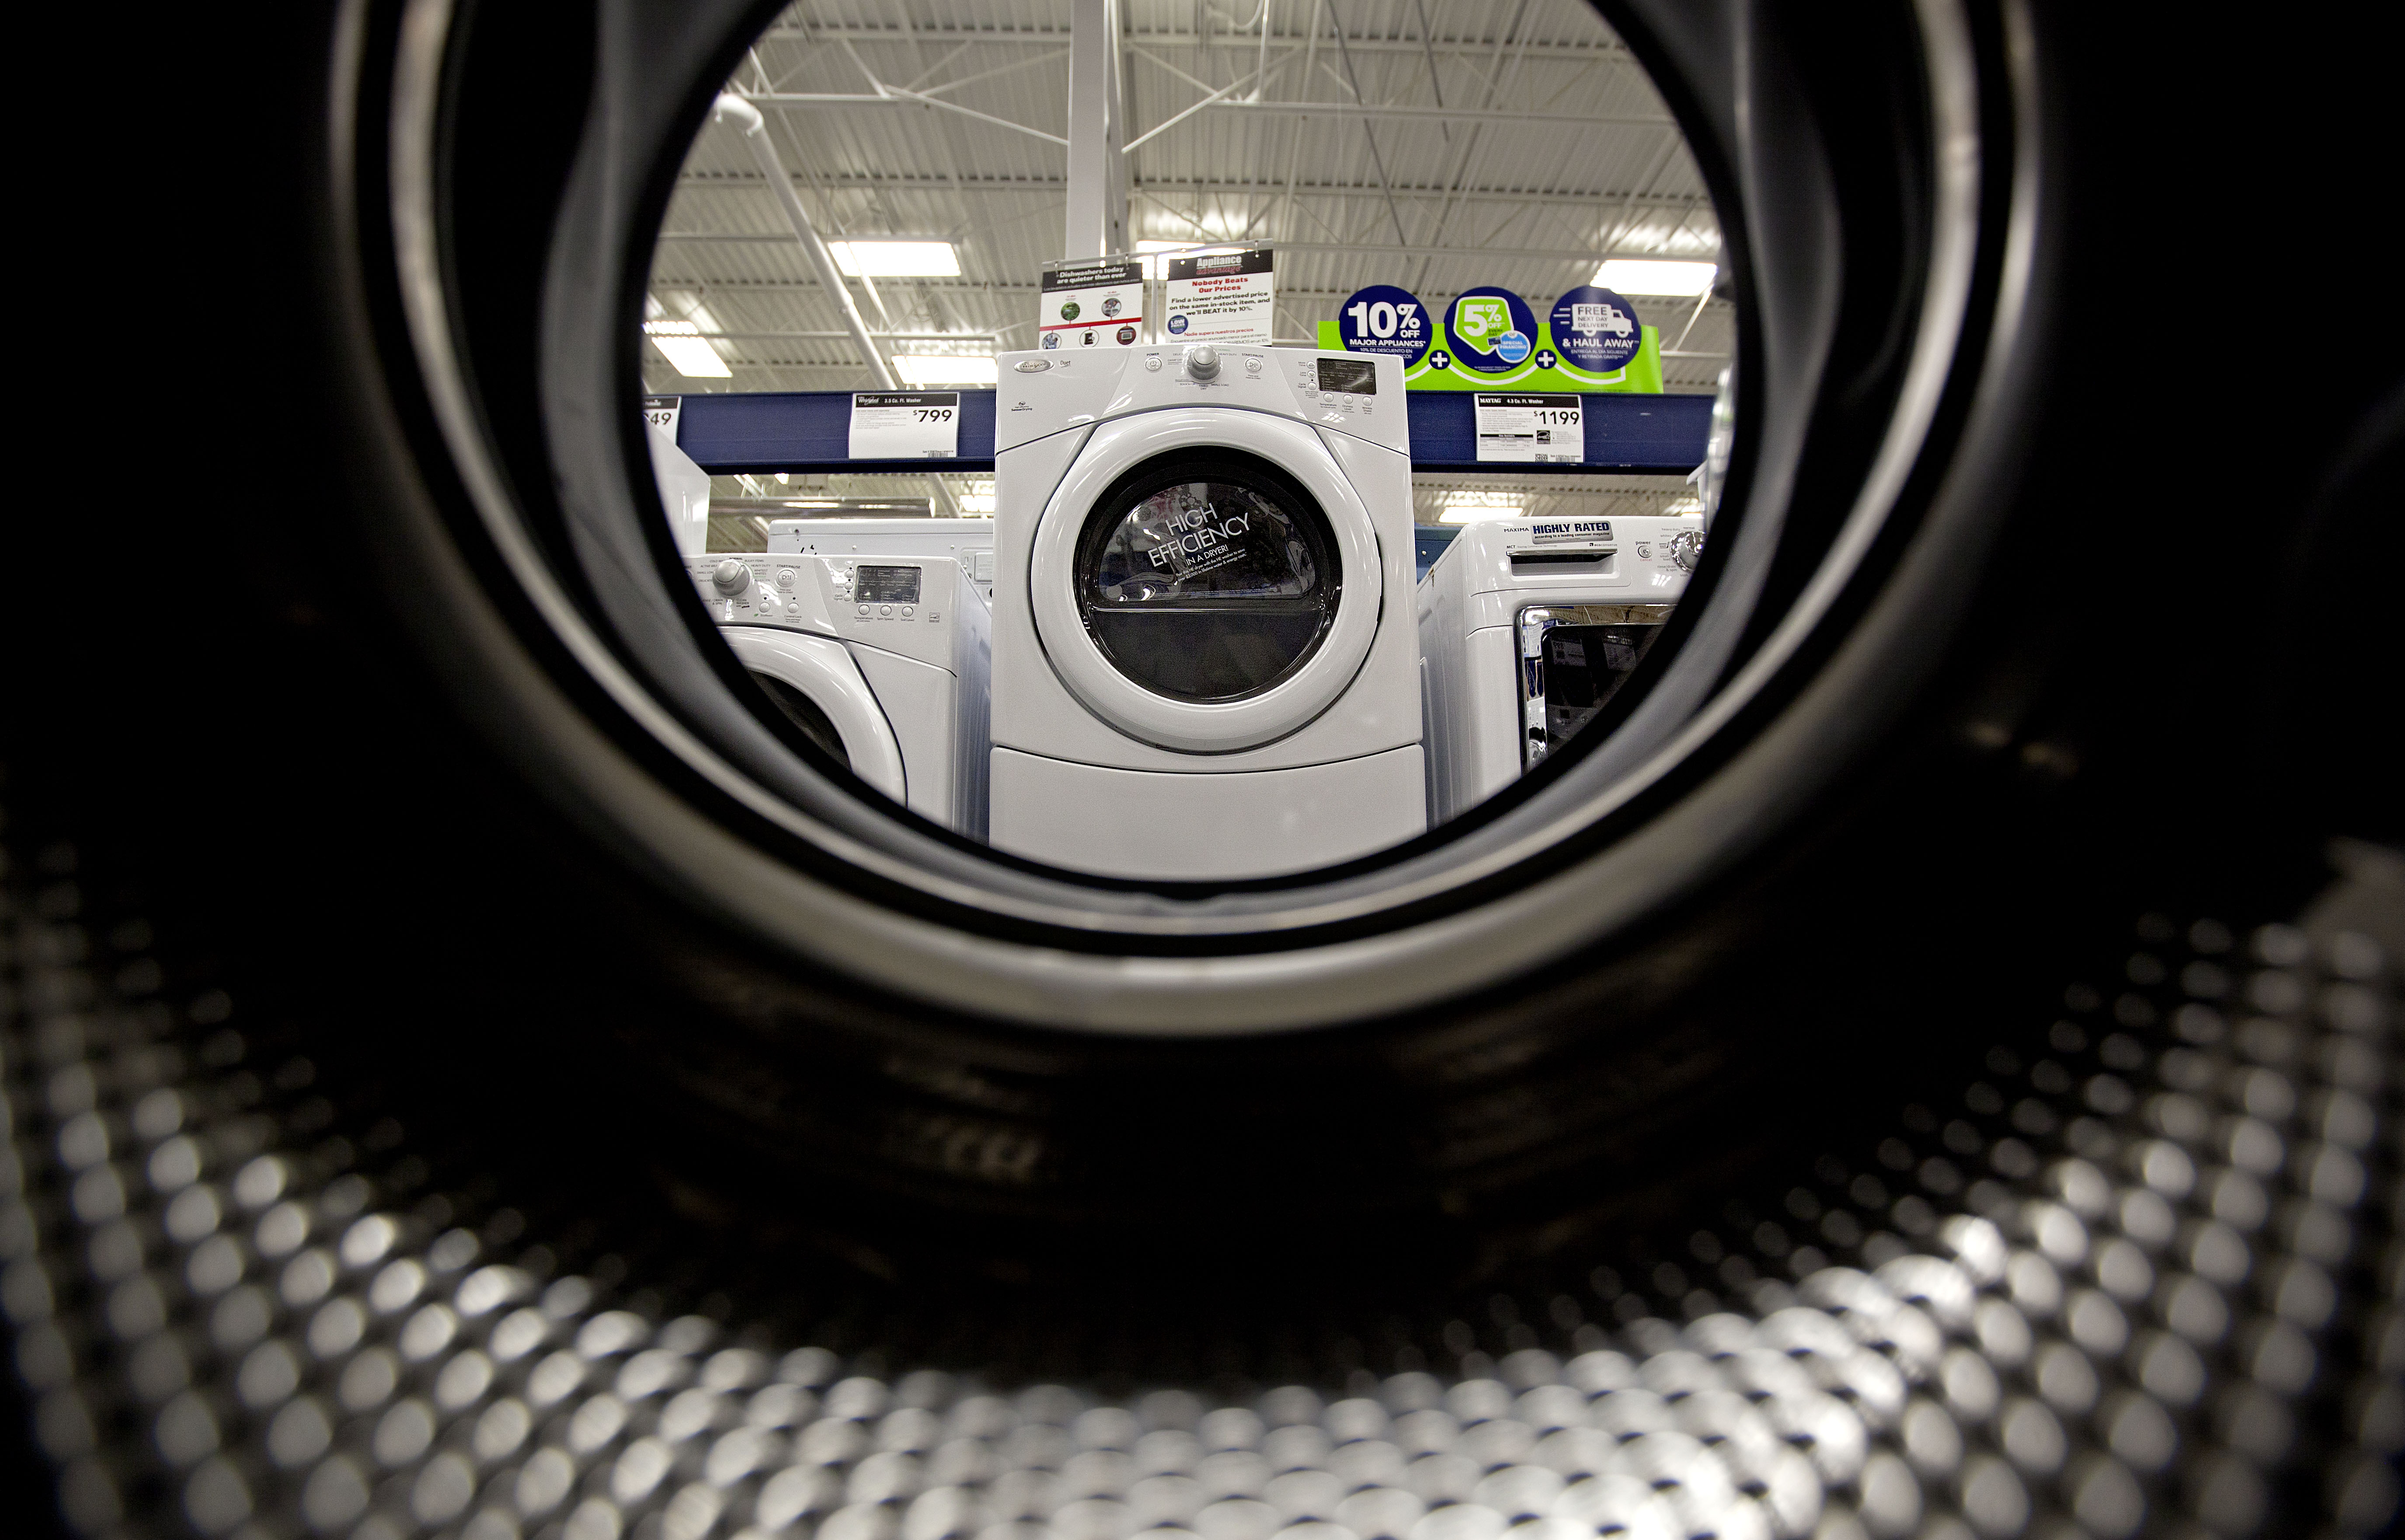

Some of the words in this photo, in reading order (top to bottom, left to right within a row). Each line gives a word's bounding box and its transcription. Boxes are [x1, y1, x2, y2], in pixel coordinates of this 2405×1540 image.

[1197, 256, 1242, 267] Appliance
[1060, 269, 1103, 278] Dishwashers
[1197, 266, 1242, 275] advantage
[1578, 306, 1607, 315] FREE
[1348, 301, 1420, 338] 10%
[1464, 305, 1502, 337] 5%
[1400, 330, 1420, 338] OFF
[1574, 338, 1602, 347] HAUL
[858, 396, 879, 405] Whirlpool
[913, 409, 952, 422] $799
[1534, 410, 1579, 424] $1199
[1166, 503, 1218, 536] HIGH
[1532, 523, 1570, 534] HIGHLY
[1574, 522, 1609, 532] RATED
[1148, 512, 1249, 567] EFFICIENCY
[1186, 557, 1196, 566] IN
[1204, 544, 1229, 559] DRYER!
